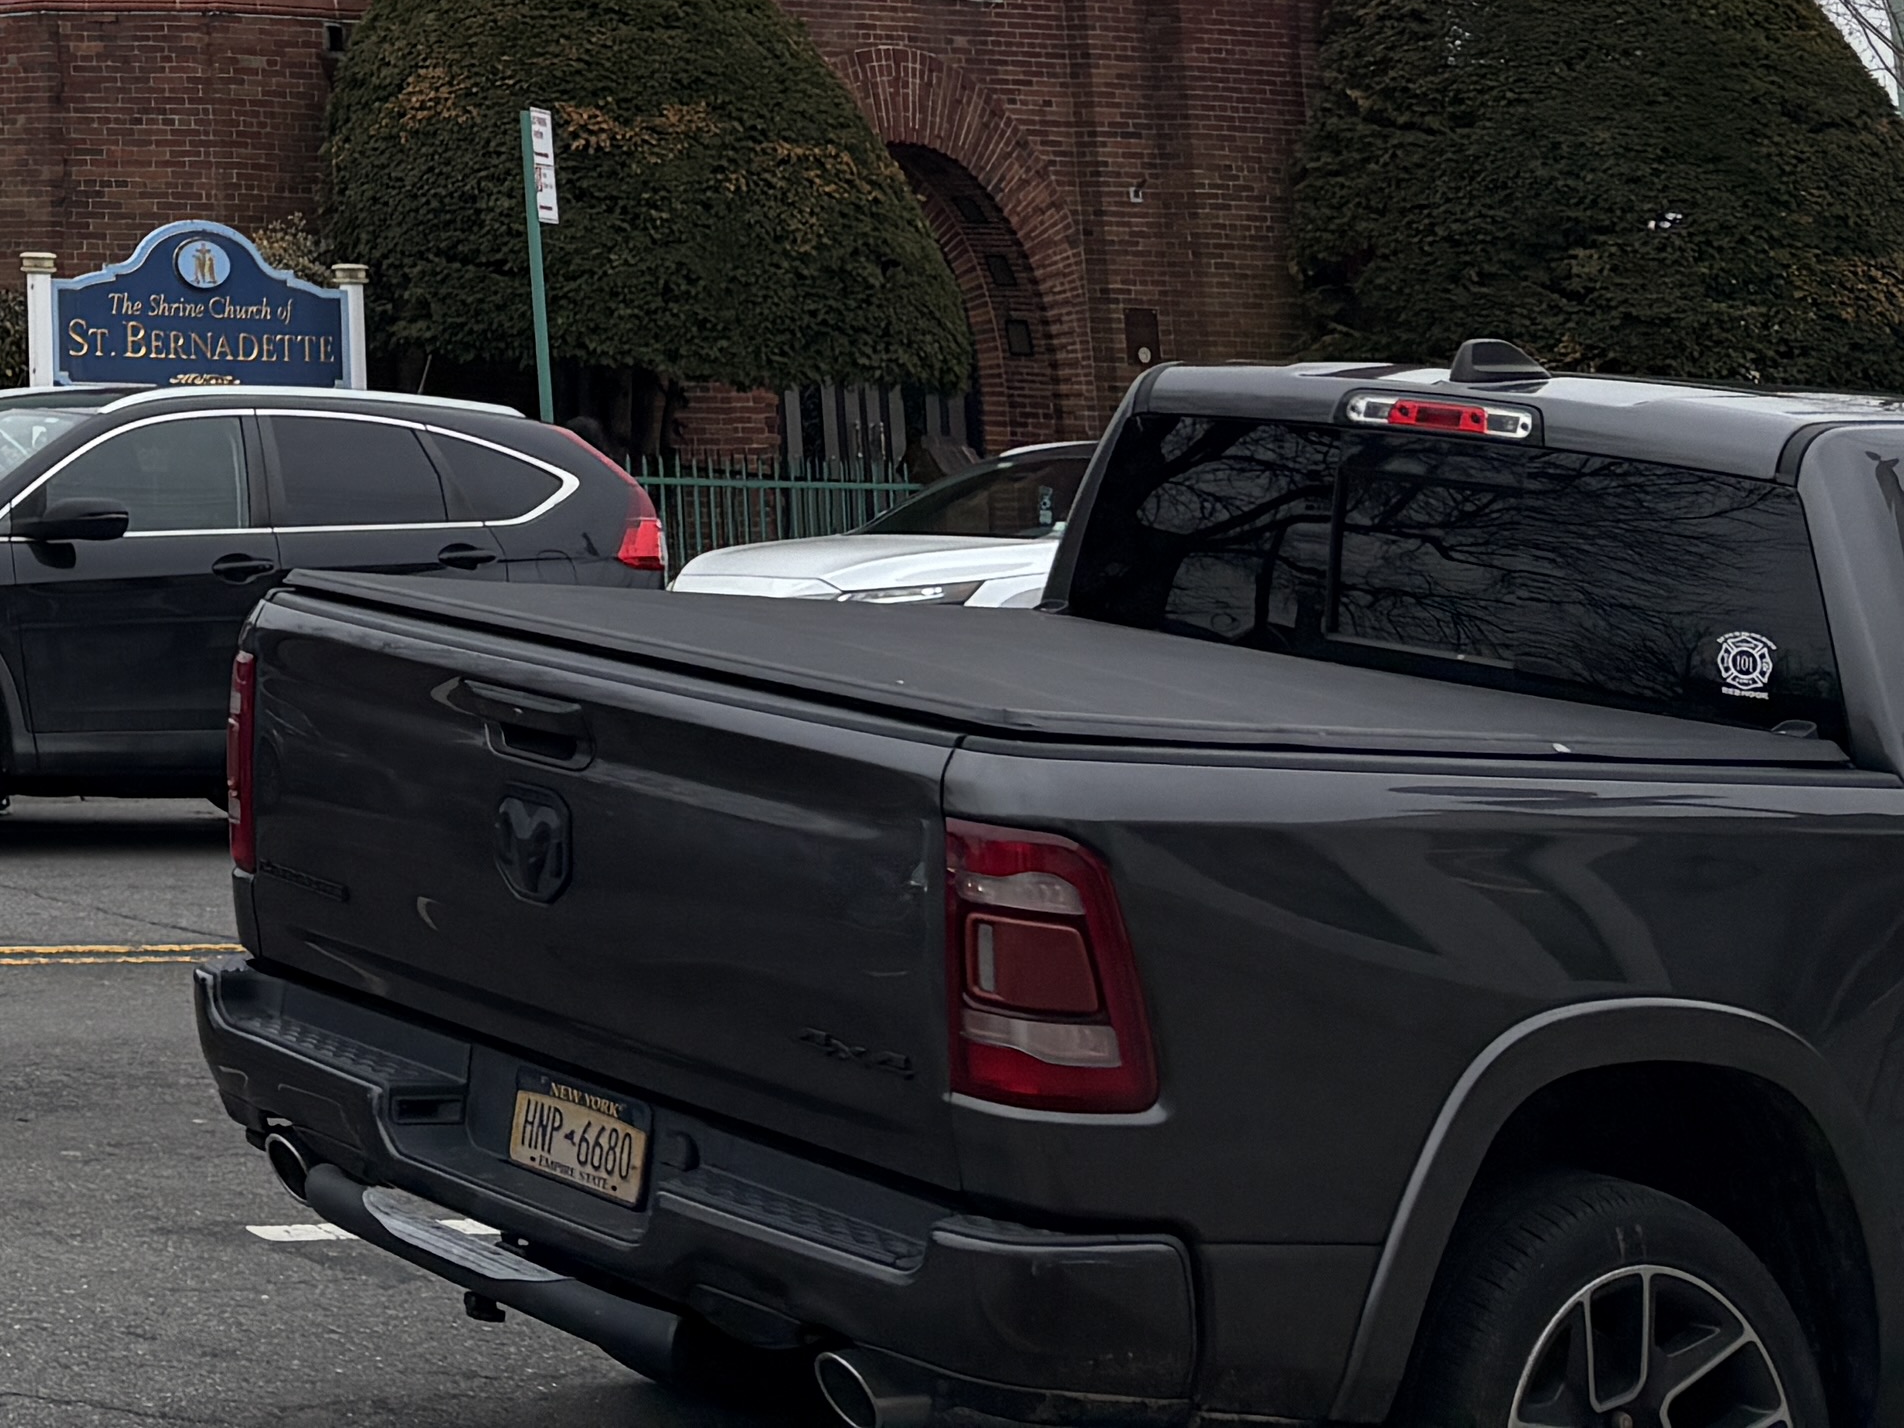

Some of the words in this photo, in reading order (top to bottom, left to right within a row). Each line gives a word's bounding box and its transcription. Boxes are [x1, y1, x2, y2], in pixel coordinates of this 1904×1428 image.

[107, 292, 142, 316] The
[148, 294, 205, 318] Shrine
[208, 296, 272, 321] Church
[276, 297, 294, 324] of
[122, 320, 336, 363] BERNADETTE
[1736, 655, 1753, 672] 101
[551, 1082, 582, 1104] NEW
[584, 1092, 620, 1118] YORK
[538, 1154, 575, 1178] EMPIRE
[579, 1171, 610, 1191] STATE
